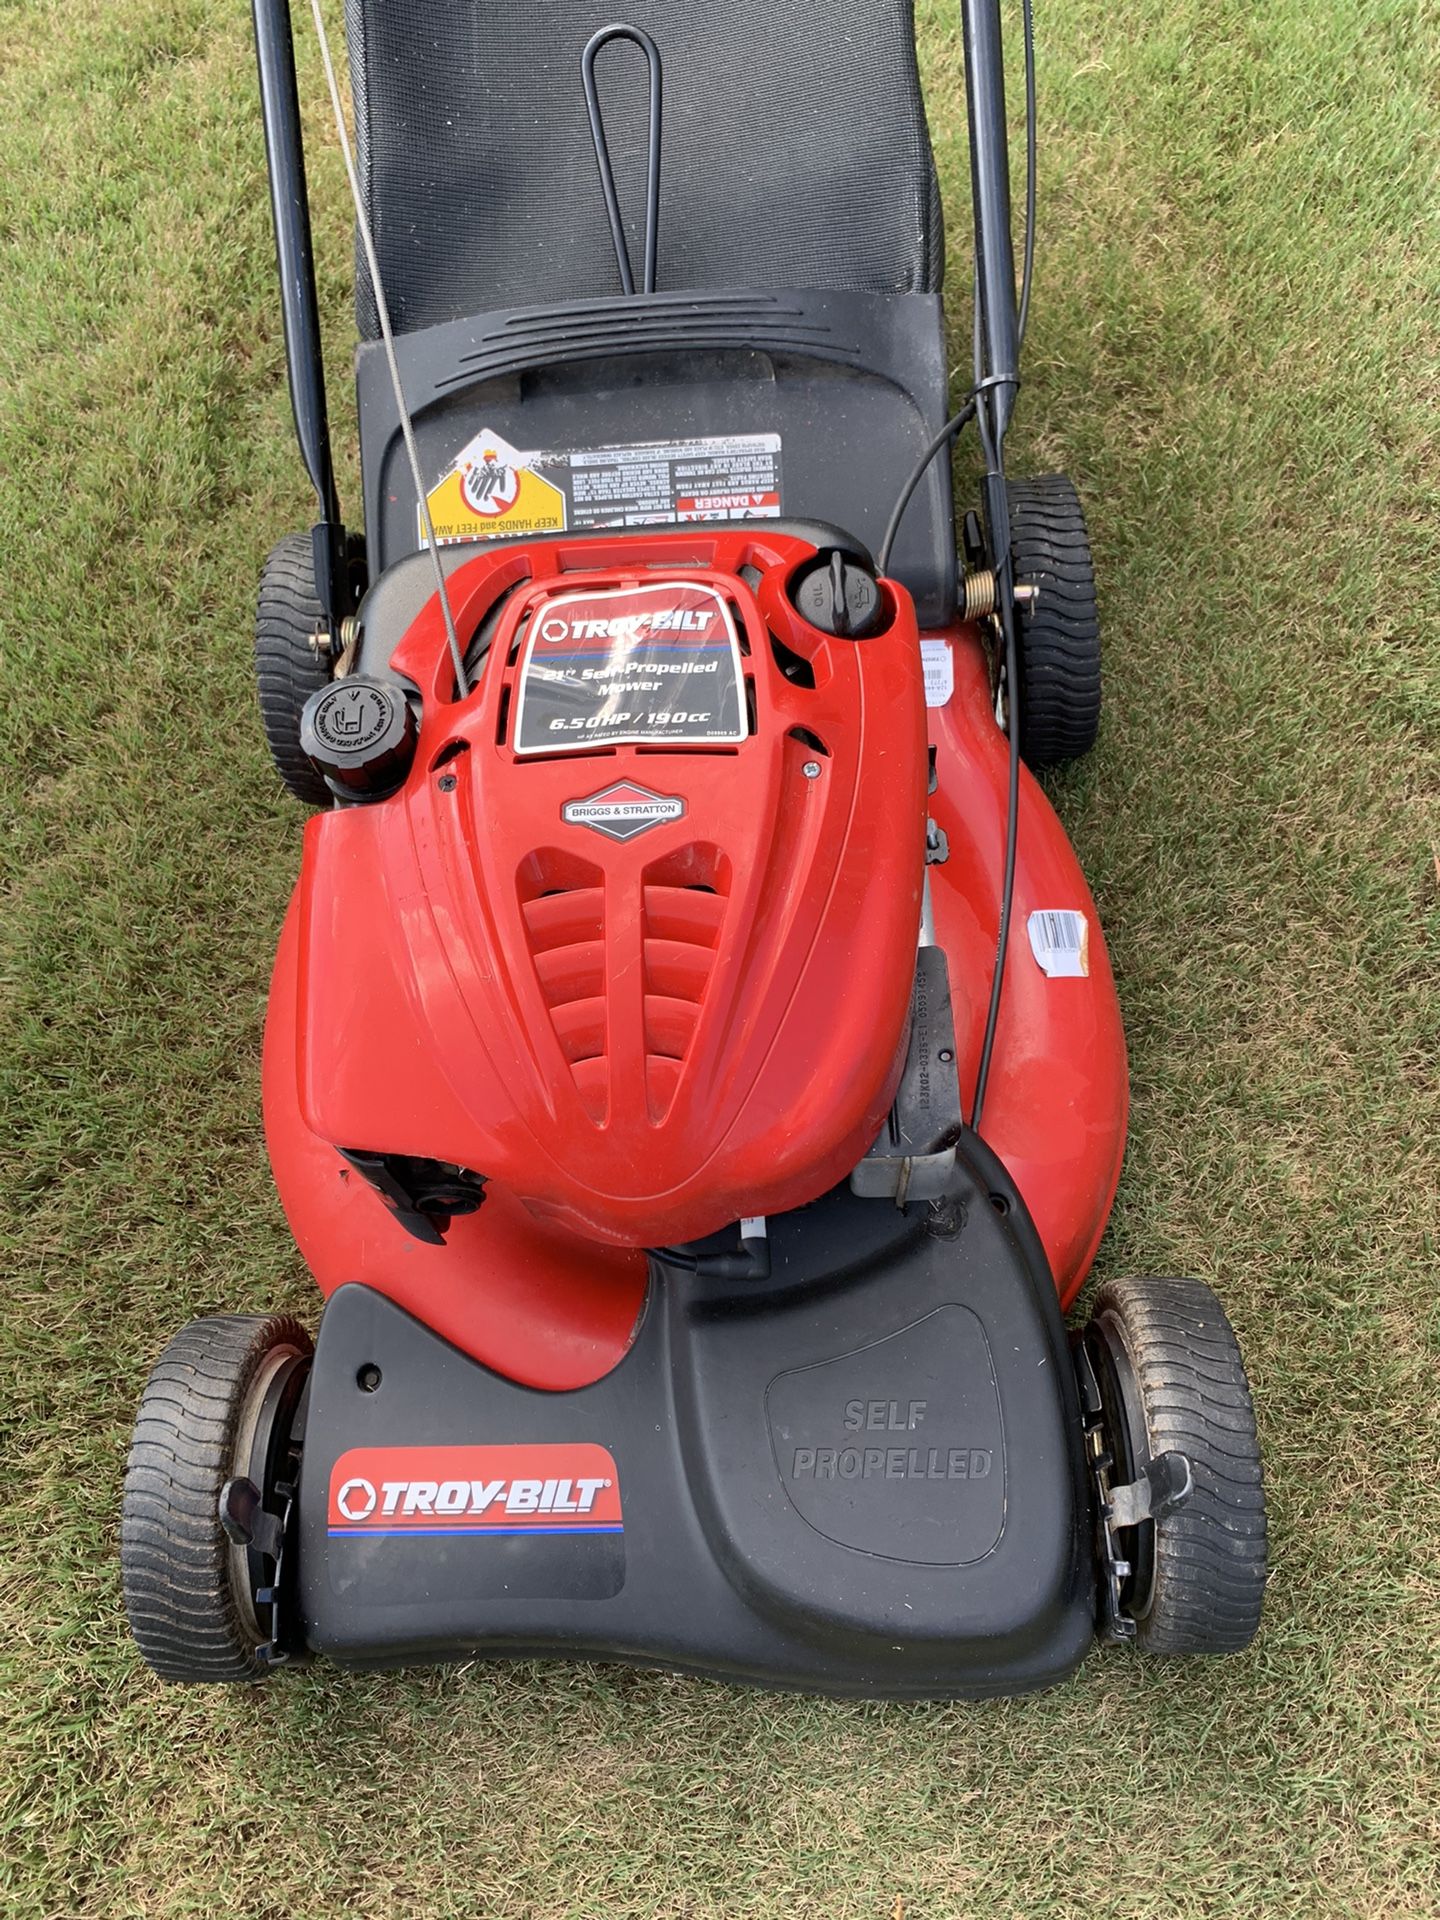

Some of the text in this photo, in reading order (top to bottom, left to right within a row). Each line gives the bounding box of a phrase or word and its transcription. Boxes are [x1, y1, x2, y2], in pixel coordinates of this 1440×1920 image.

[694, 494, 749, 509] DANGER
[434, 517, 558, 535] KEEP HANDS and FEET AWA
[813, 584, 823, 607] OIL
[582, 661, 718, 682] Self-Propelled
[598, 680, 662, 696] Mower
[633, 712, 644, 724] /
[646, 711, 711, 725] 190cc
[572, 805, 675, 817] BRIGGS & STRATTON
[843, 1400, 927, 1431] SELF
[793, 1447, 992, 1480] PROPELLED
